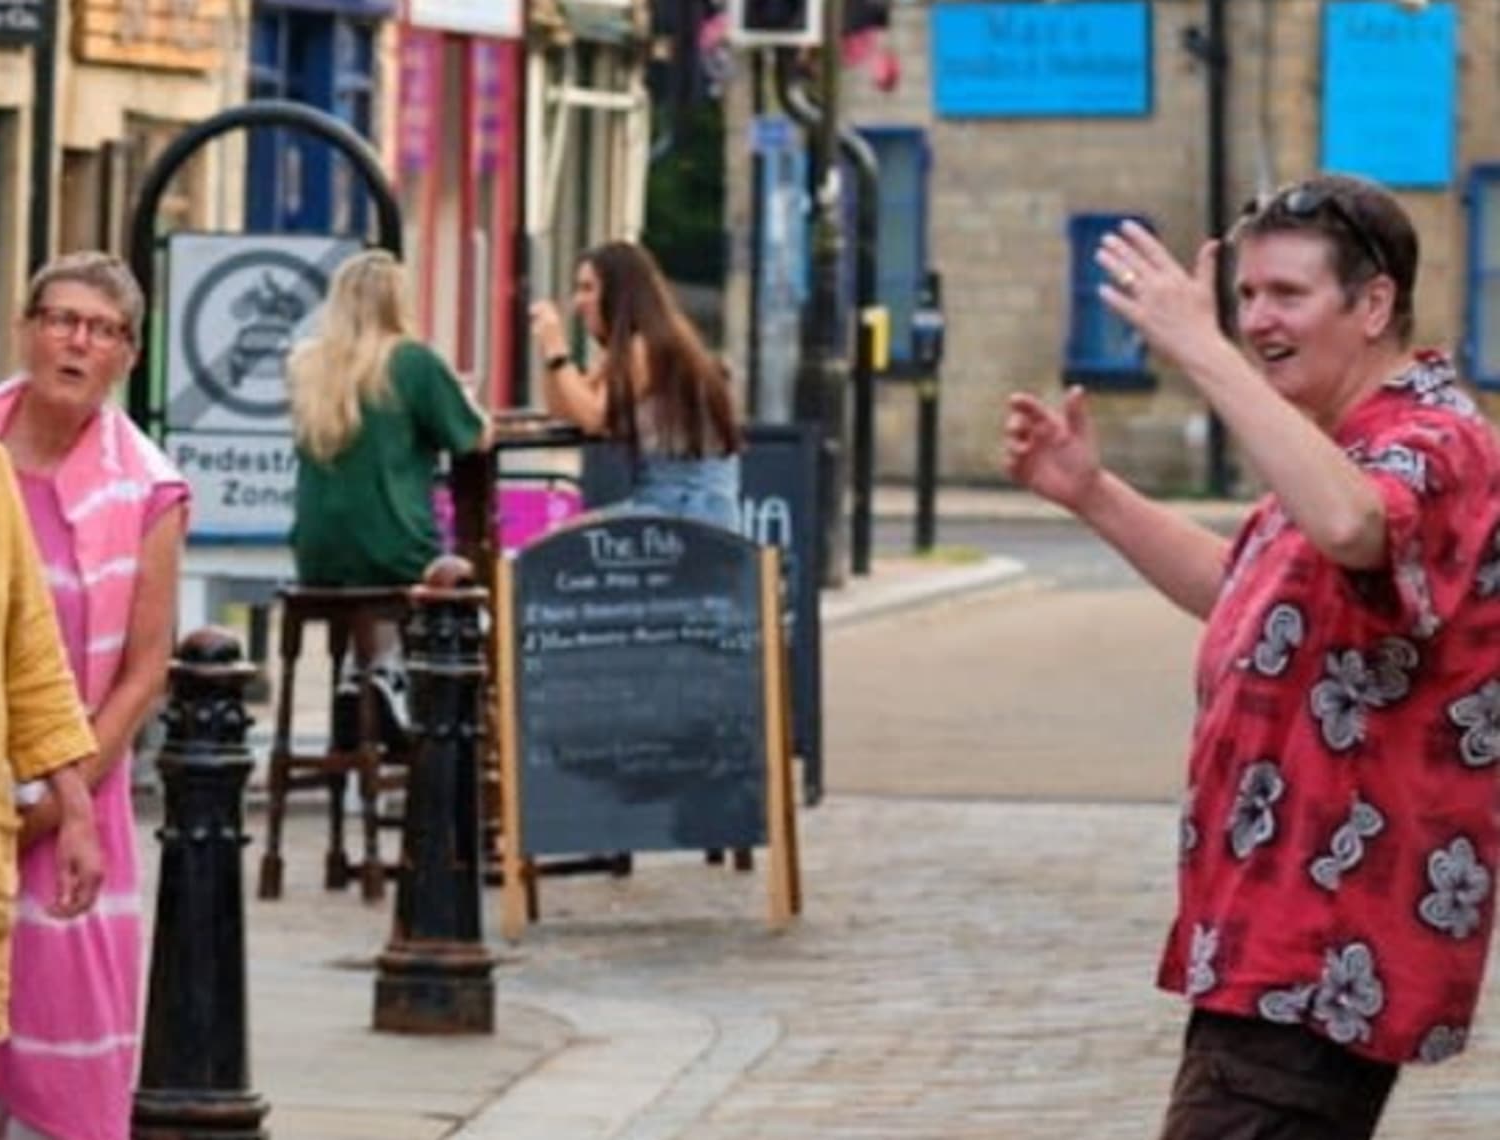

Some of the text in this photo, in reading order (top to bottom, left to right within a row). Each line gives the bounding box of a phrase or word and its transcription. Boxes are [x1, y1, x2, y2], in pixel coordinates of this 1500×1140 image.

[176, 444, 298, 474] Pedestr
[220, 479, 298, 507] Zone
[582, 527, 632, 561] The
